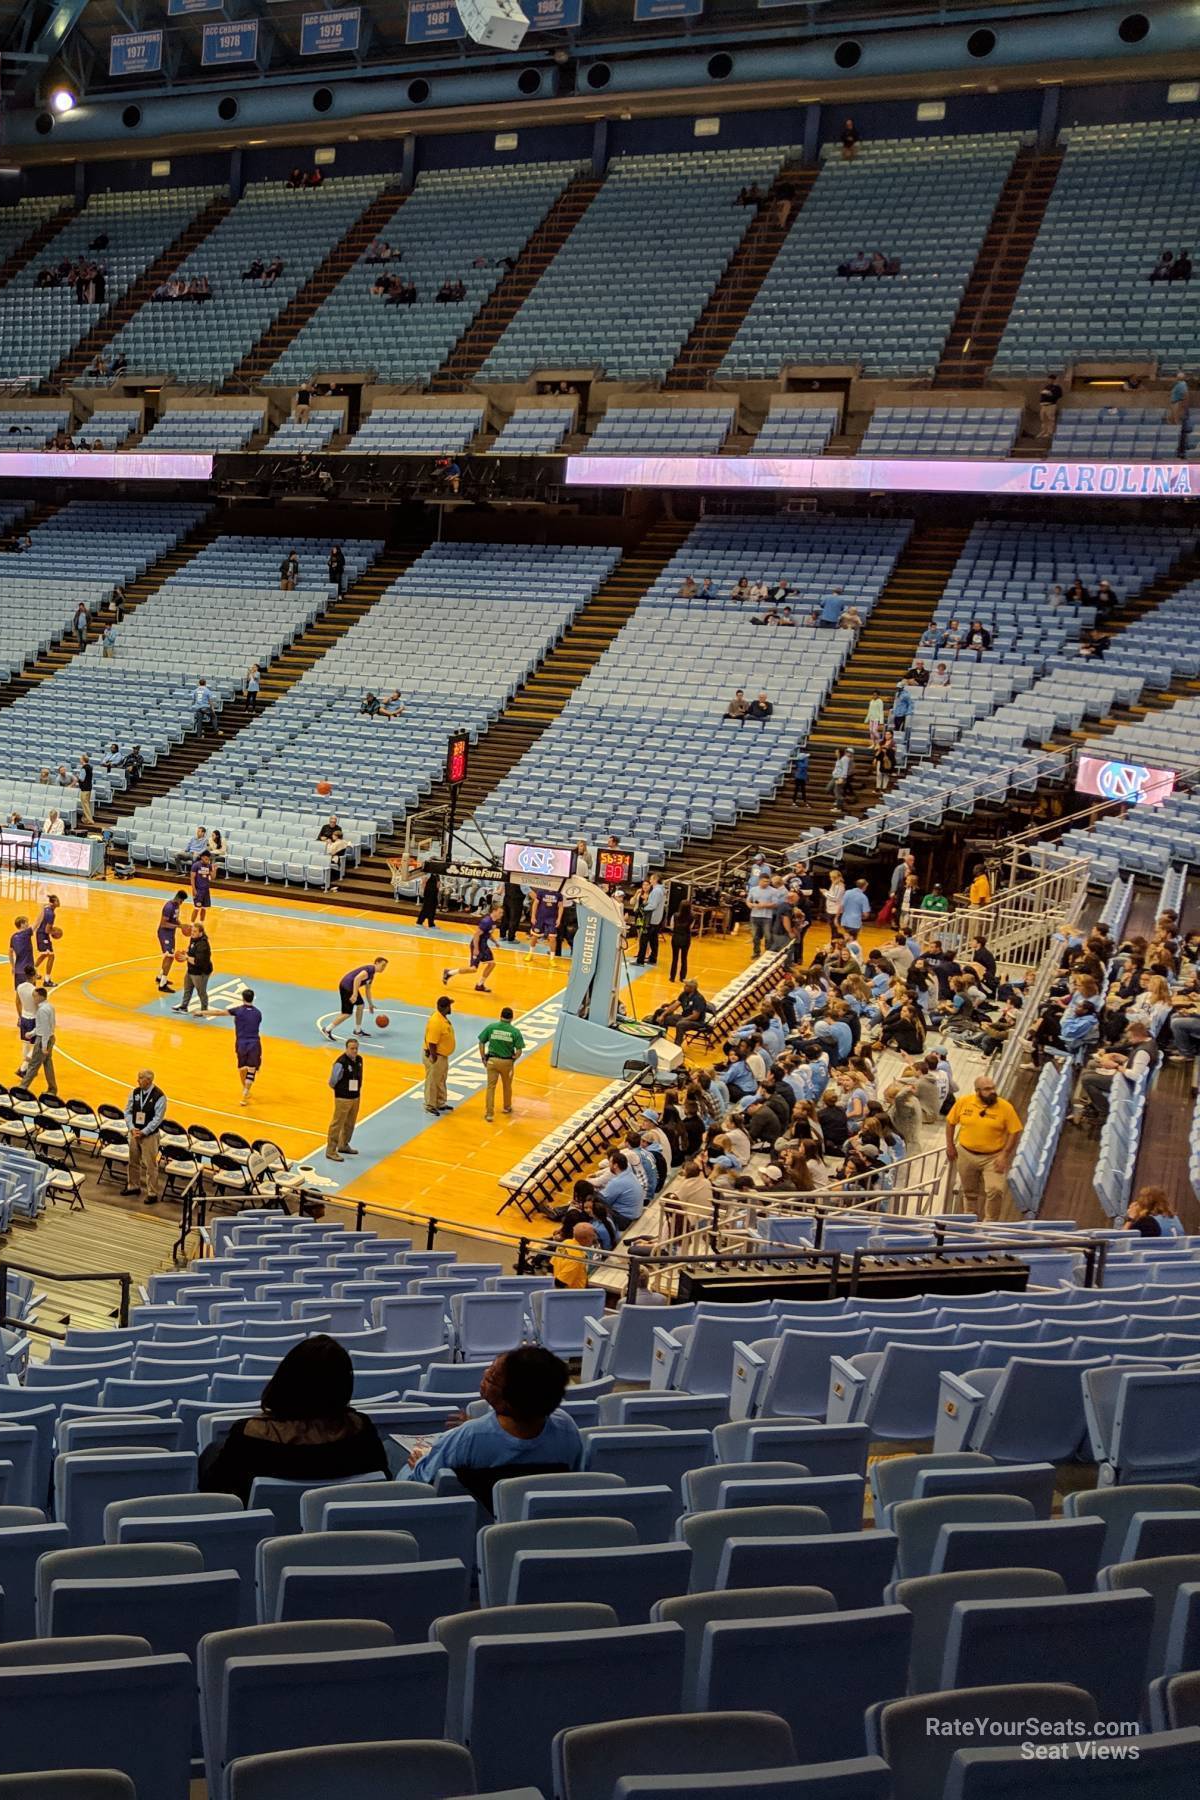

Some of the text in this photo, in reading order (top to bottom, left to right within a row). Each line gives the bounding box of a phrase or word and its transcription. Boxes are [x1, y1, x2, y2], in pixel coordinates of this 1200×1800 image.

[427, 12, 450, 26] 1981
[320, 24, 342, 38] 1979
[127, 46, 146, 59] 1977
[1029, 464, 1192, 494] CAROLINA
[460, 866, 503, 879] StateFarm
[606, 864, 622, 879] 30
[581, 915, 598, 974] @GOHEELS
